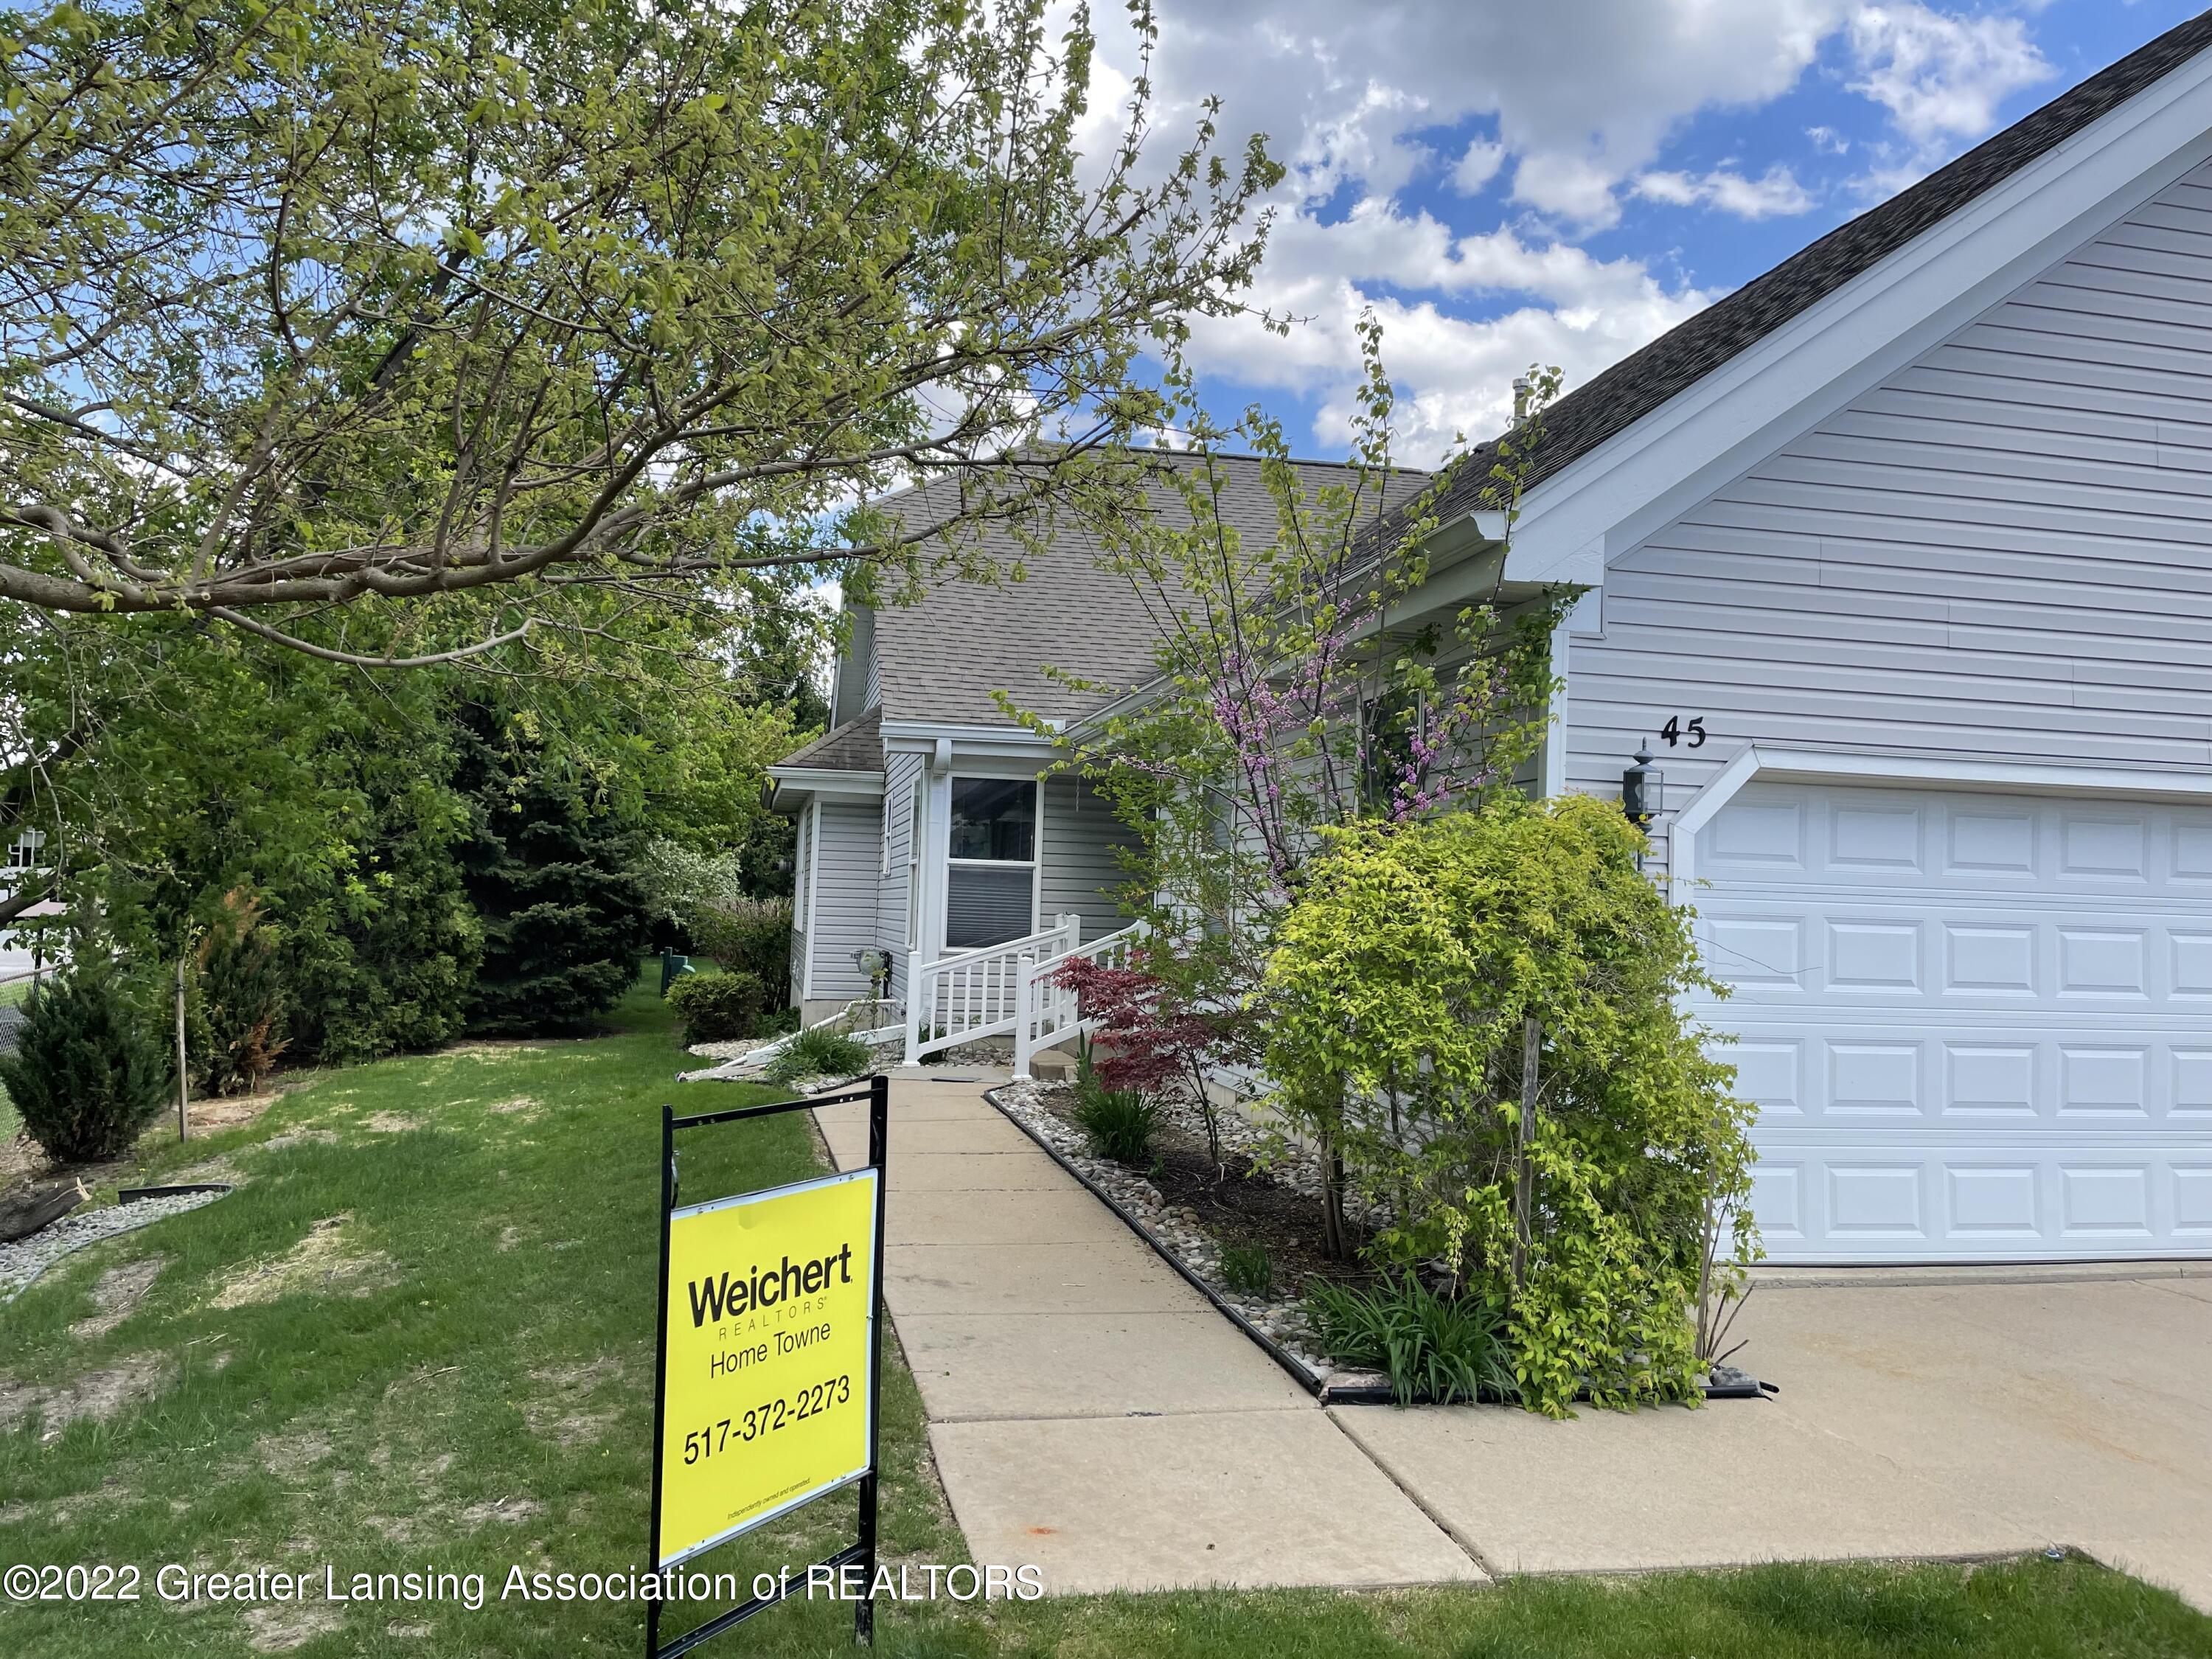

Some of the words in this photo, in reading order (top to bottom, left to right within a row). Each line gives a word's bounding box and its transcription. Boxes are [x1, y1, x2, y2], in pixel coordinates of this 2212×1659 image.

[1660, 715, 1706, 748] 45
[710, 1343, 768, 1379] Home
[773, 1323, 831, 1356] Towne
[684, 1374, 849, 1465] 517-372-2273
[727, 1499, 762, 1520] Independently
[762, 1491, 779, 1504] owned
[779, 1486, 789, 1497] and
